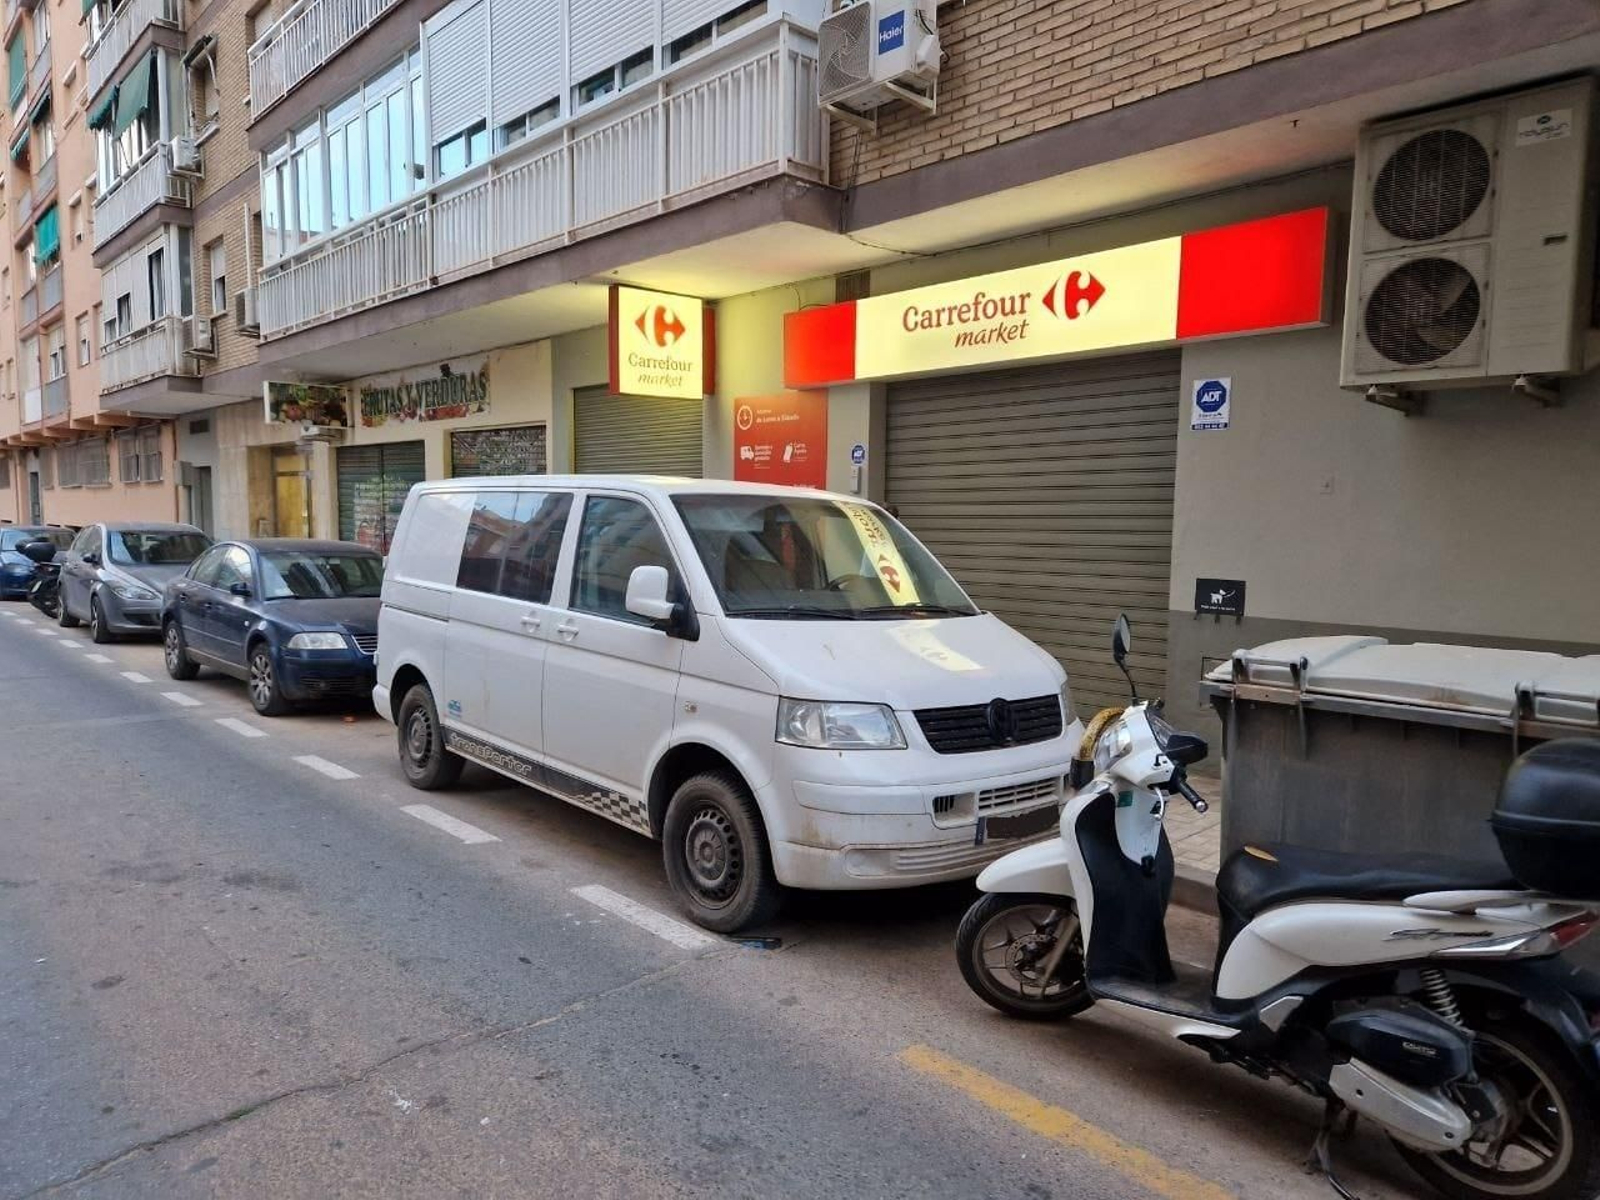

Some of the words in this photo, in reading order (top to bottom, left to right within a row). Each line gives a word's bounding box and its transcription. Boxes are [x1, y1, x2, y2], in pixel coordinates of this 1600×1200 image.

[879, 25, 903, 43] Haier
[902, 291, 1031, 332] Carrefour
[954, 319, 1029, 348] market
[628, 352, 693, 372] Carrefour
[415, 370, 488, 408] VERDURAS
[638, 374, 682, 388] market
[1201, 390, 1223, 403] ADT
